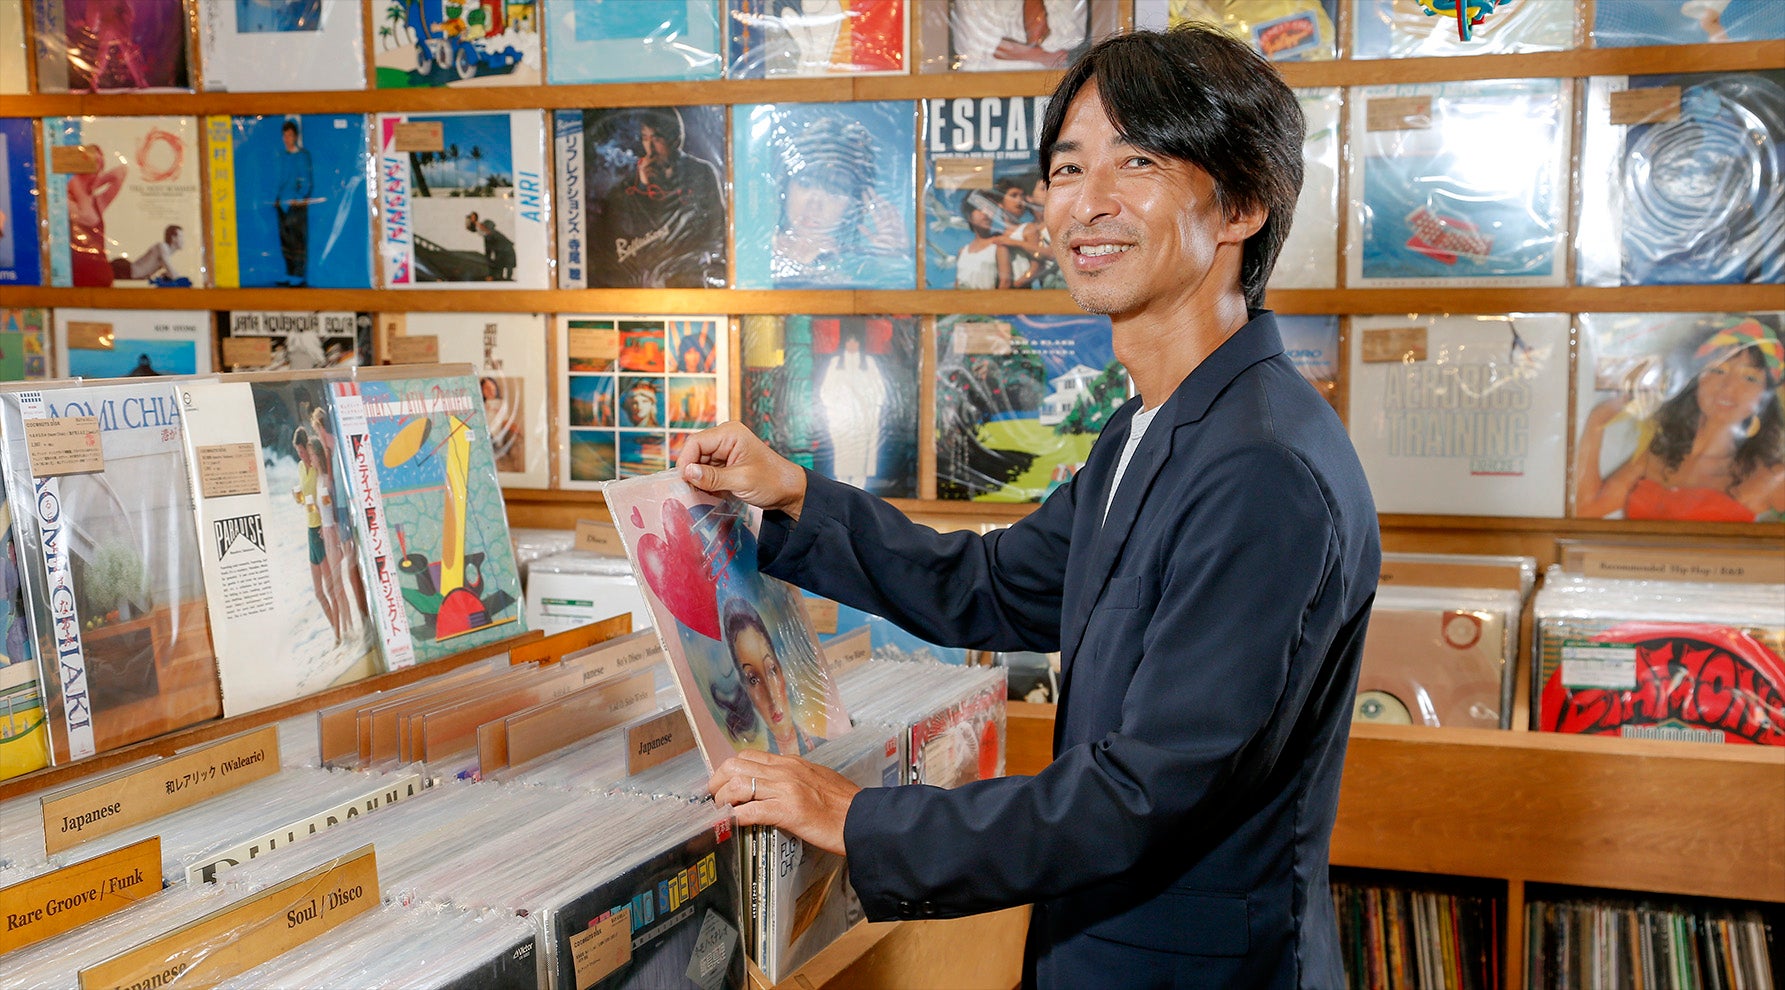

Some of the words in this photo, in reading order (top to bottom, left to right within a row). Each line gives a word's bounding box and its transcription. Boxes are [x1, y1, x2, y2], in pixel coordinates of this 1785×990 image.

[519, 171, 541, 222] ANRI
[1386, 410, 1528, 458] TRAINING
[214, 515, 266, 560] PARADISE
[52, 587, 90, 732] CHIAKI
[638, 732, 673, 756] Japanese
[60, 801, 122, 834] Japanese
[164, 764, 217, 796] 和レアリック
[220, 748, 266, 777] (Walearic)
[6, 907, 43, 933] Rare
[45, 887, 98, 917] Groove
[107, 868, 145, 895] Funk
[286, 899, 318, 930] Soul
[328, 884, 364, 910] Disco
[658, 853, 718, 915] STEREO
